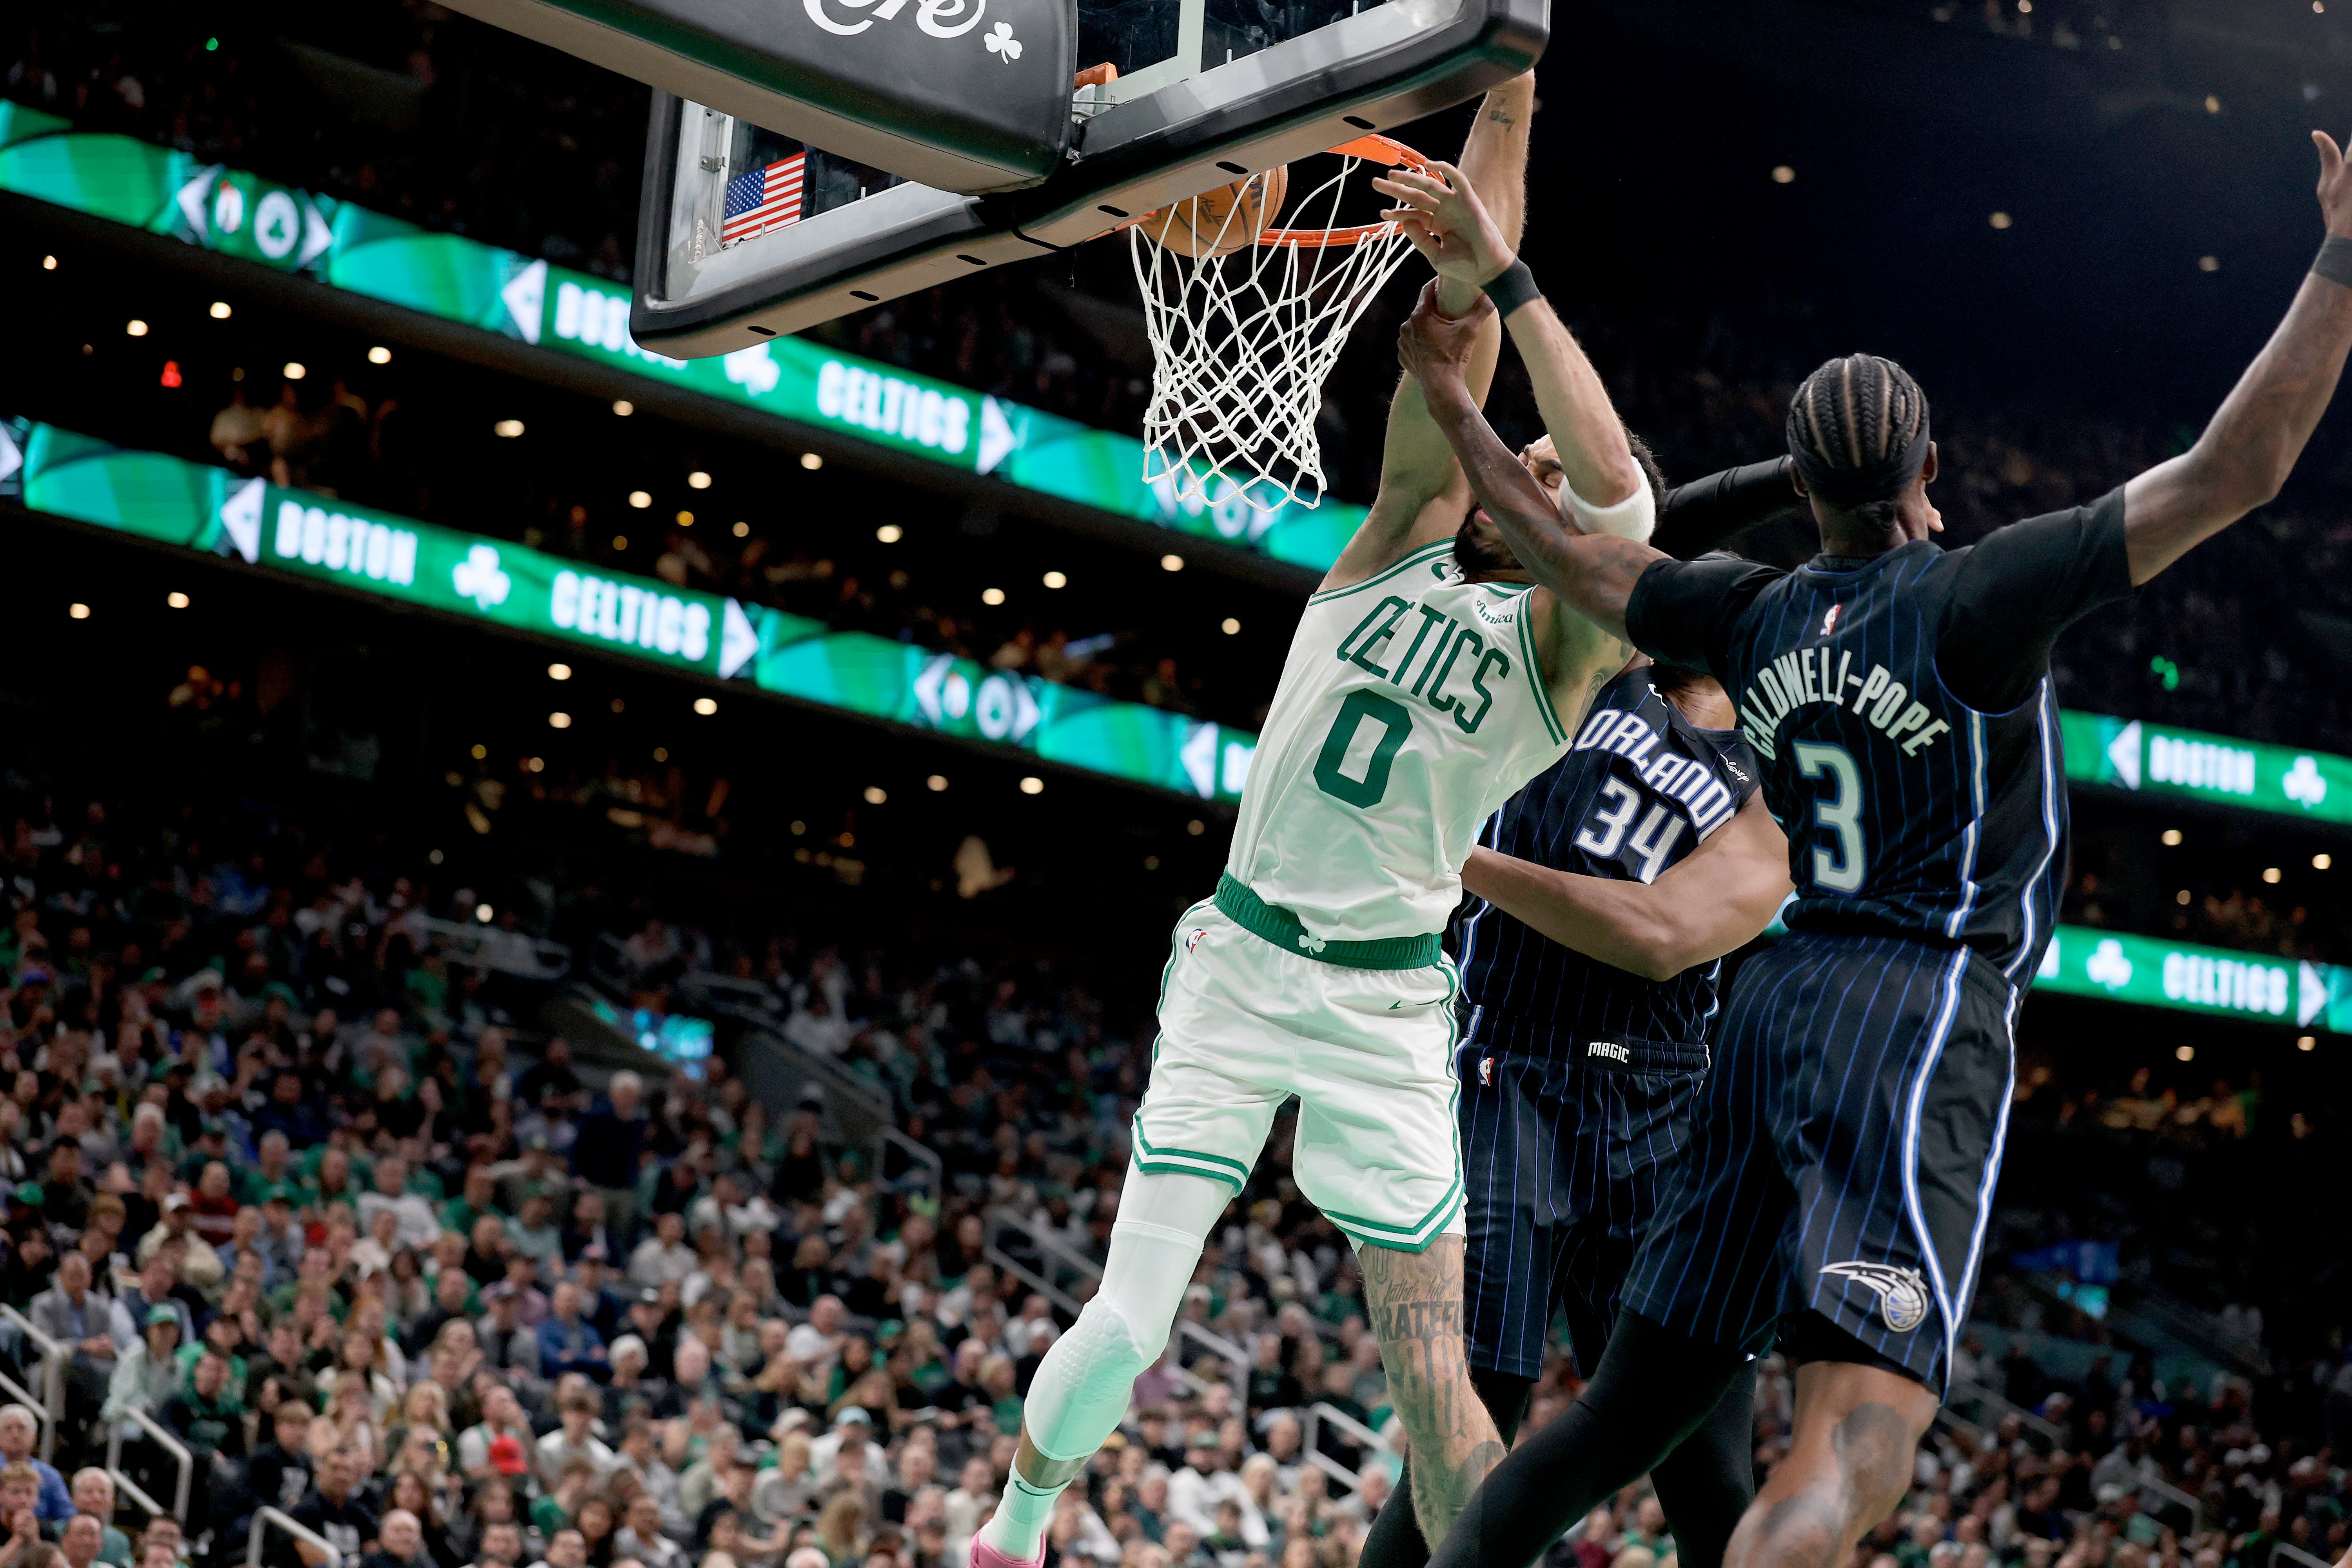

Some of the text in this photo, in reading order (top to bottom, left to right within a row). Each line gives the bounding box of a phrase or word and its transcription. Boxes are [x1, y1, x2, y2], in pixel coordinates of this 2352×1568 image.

[555, 282, 970, 454] BOS CELTICS
[275, 501, 711, 661] BOSTON CELTICS
[1477, 600, 1513, 624] Amica
[1337, 596, 1510, 733] CETICS
[1741, 647, 1951, 761] CALDWELL-POPE
[1313, 688, 1413, 809] 0
[1573, 774, 1687, 885] 34
[1792, 738, 1867, 898] 3
[2163, 952, 2288, 1016] CELTICS
[1588, 1042, 1630, 1064] MAGIC
